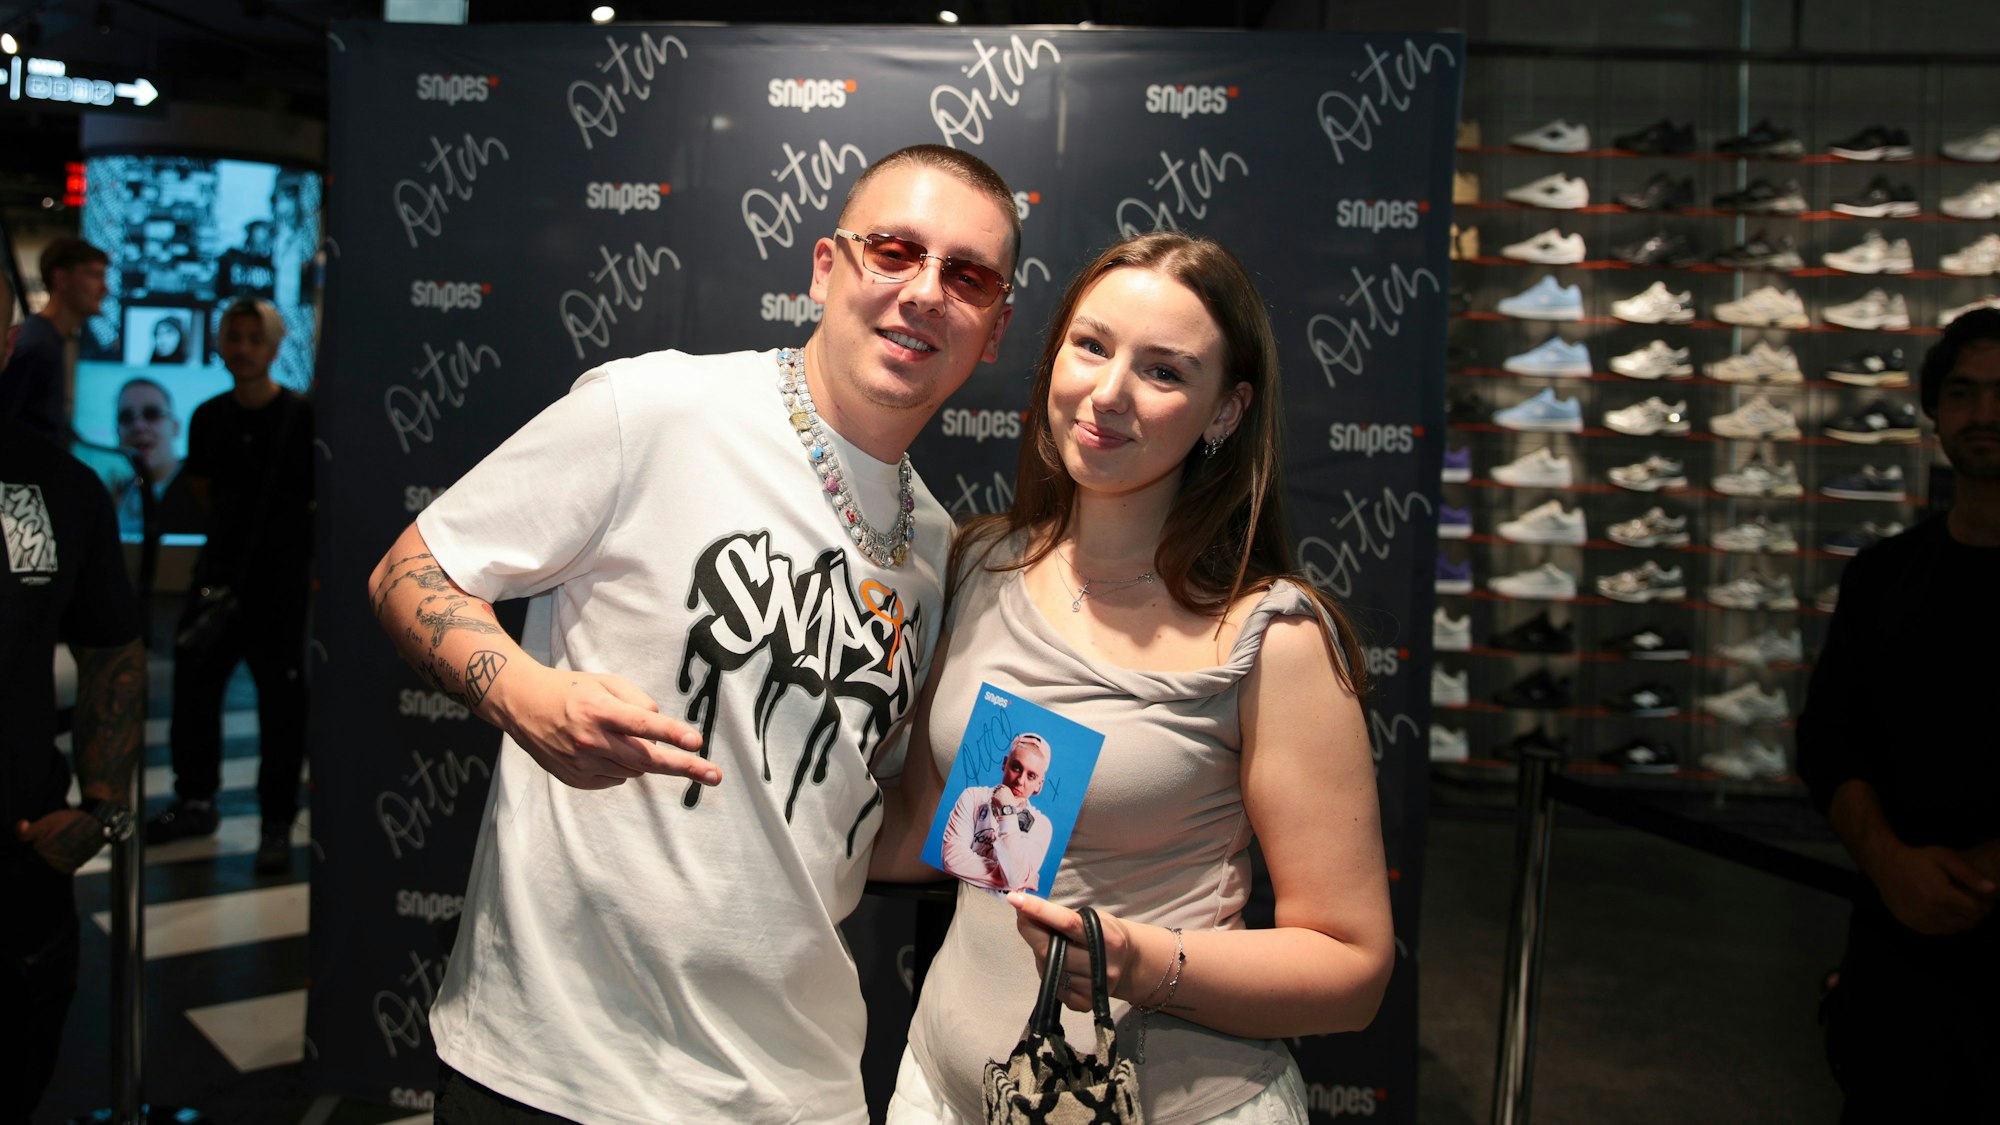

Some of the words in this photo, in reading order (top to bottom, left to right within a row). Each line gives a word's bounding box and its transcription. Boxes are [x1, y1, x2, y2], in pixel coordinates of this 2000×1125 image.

[417, 74, 489, 105] snipes
[769, 77, 847, 113] snipes
[1146, 84, 1227, 118] snipes
[587, 182, 661, 215] snipes
[1336, 199, 1419, 234] snipes
[411, 280, 483, 312] snipes
[761, 293, 823, 326] snipe
[942, 407, 1021, 442] snipes
[1329, 422, 1414, 458] snipes
[984, 691, 1009, 708] snipes
[1304, 1082, 1376, 1118] nipes
